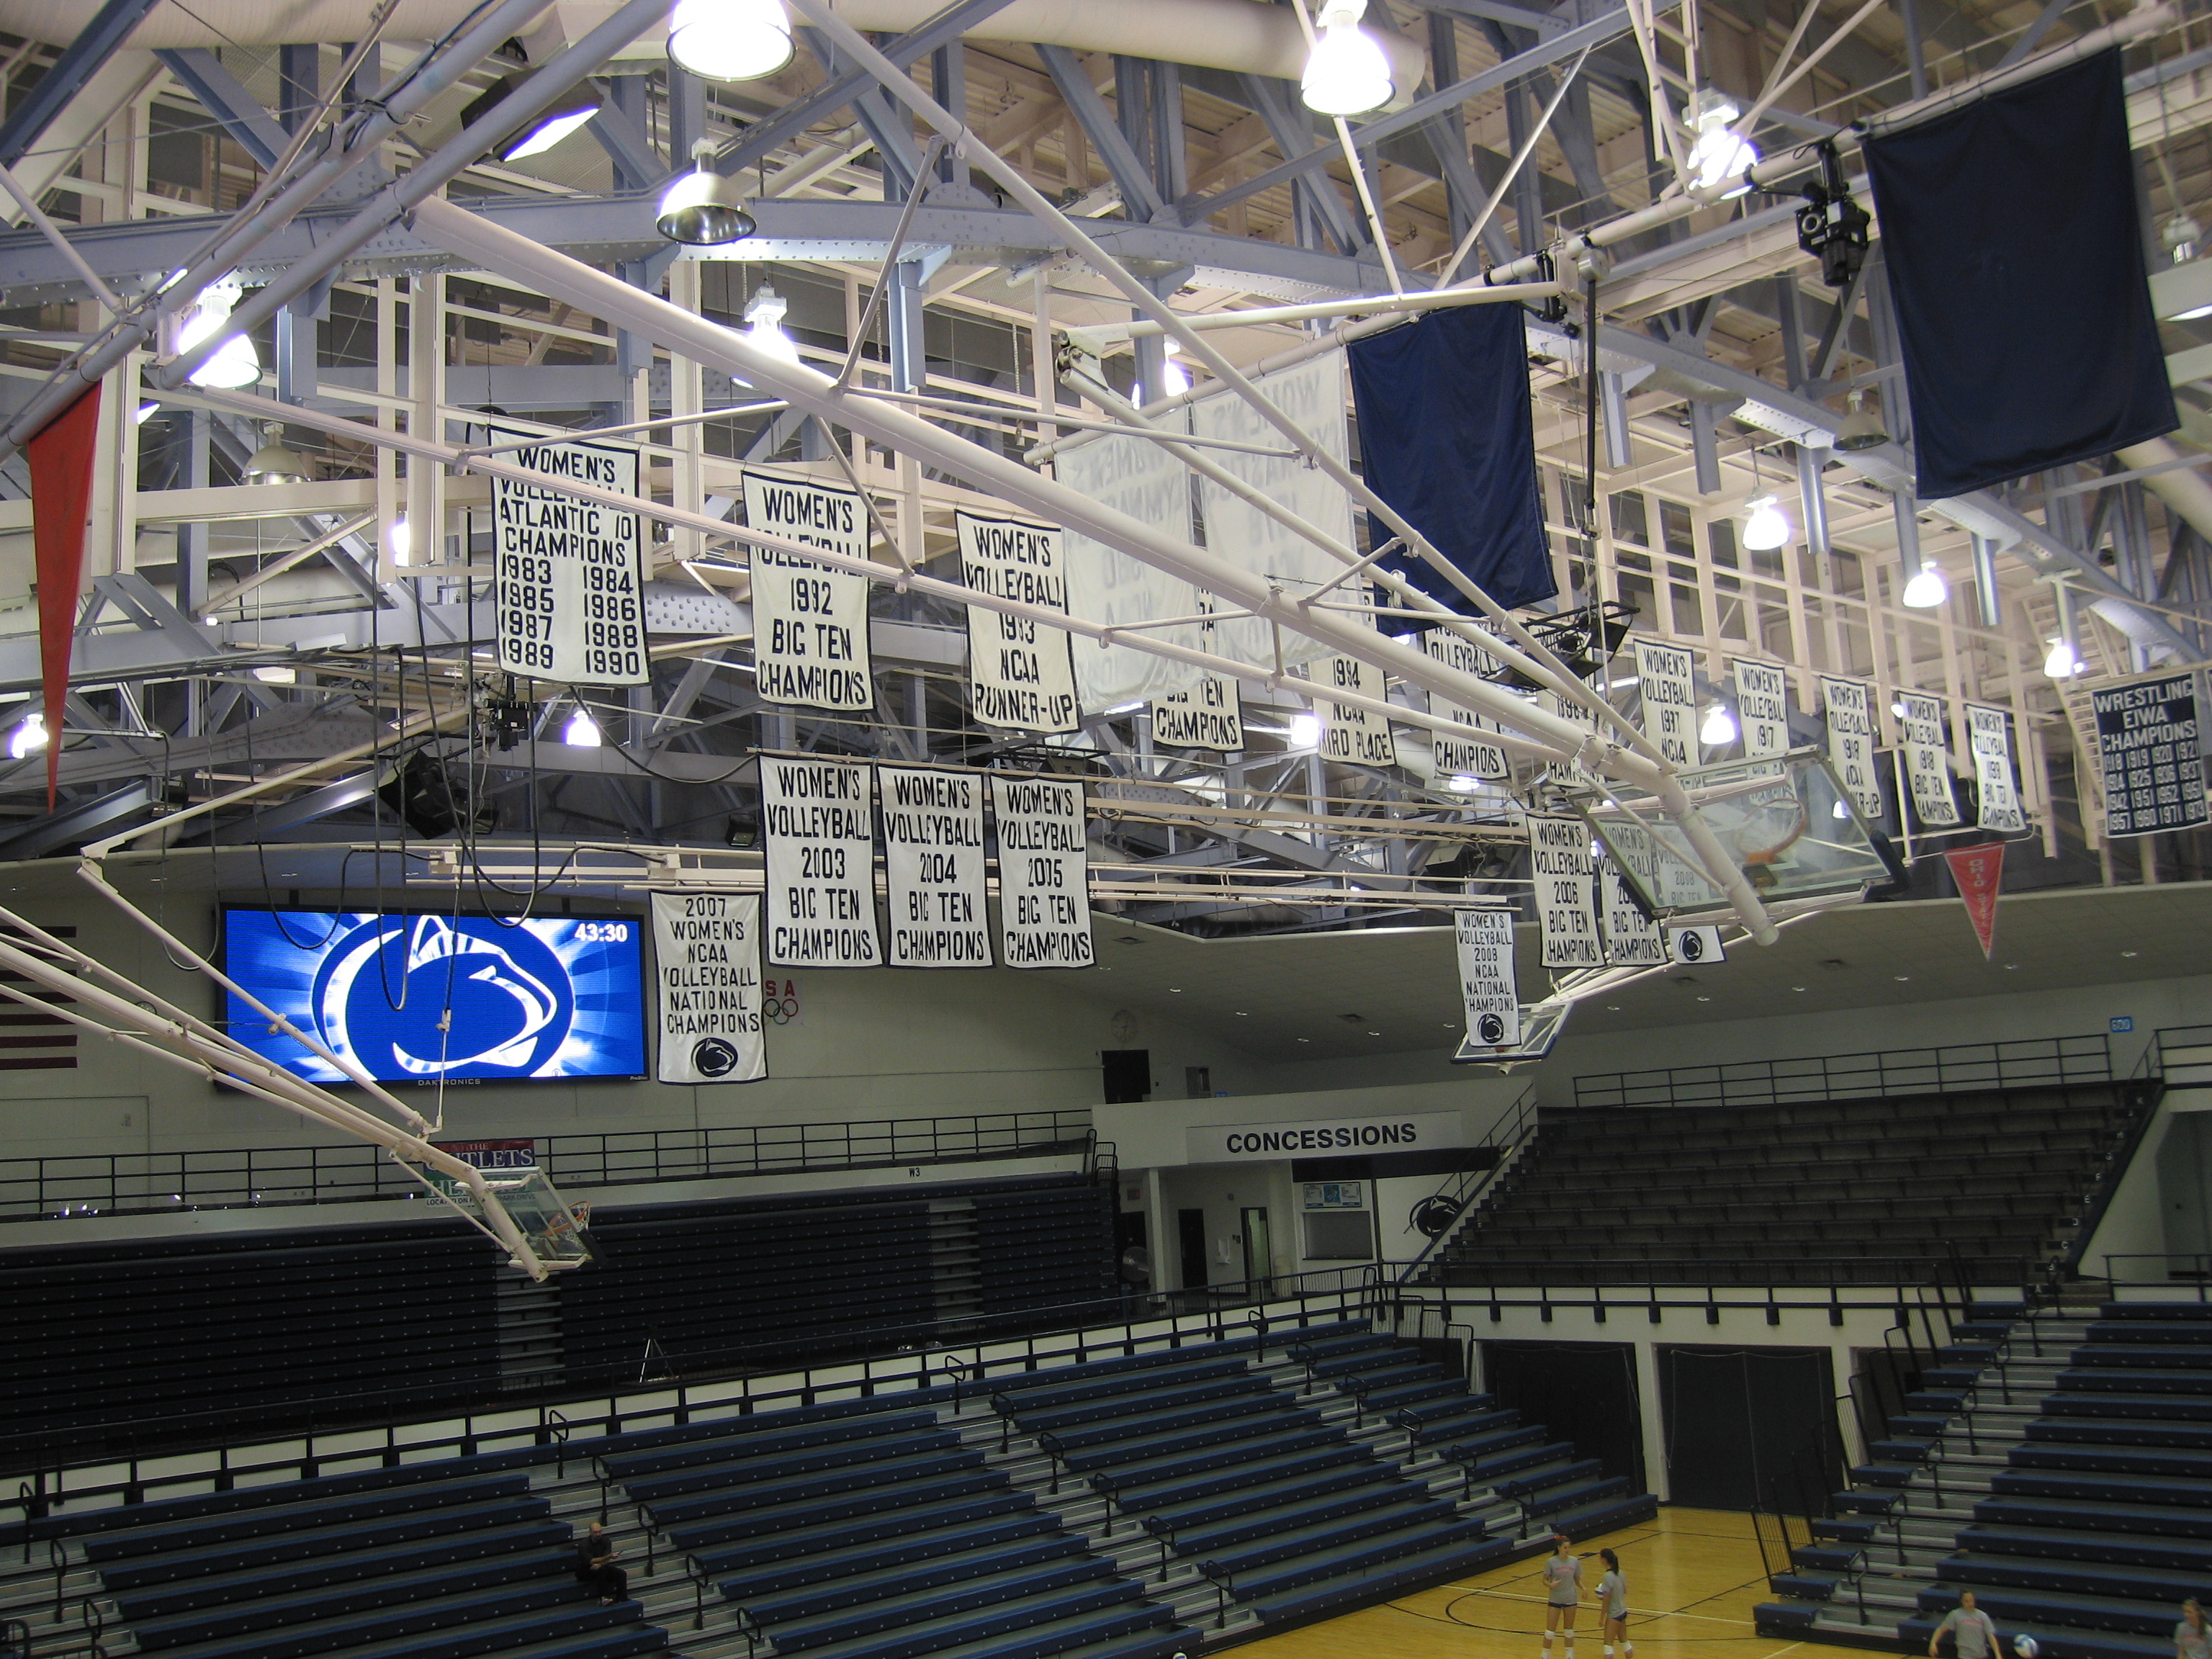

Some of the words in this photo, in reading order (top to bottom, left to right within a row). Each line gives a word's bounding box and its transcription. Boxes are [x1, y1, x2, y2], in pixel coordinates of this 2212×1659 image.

[518, 446, 615, 483] WOMEN'S
[500, 498, 600, 535] ATLANTIC
[616, 514, 631, 540] 10
[763, 487, 853, 533] WOMEN'S
[505, 526, 626, 567] CHAMPIONS
[974, 526, 1051, 567] WOMEN'S
[502, 552, 552, 584] 1983
[583, 565, 634, 595] 1984
[965, 561, 1062, 607] VOLLEYBALL
[501, 580, 554, 613] 1985
[584, 593, 636, 621] 1986
[791, 578, 833, 615] 1992
[501, 608, 552, 641] 1987
[585, 620, 638, 648] 1988
[772, 619, 805, 655] BIG
[815, 623, 852, 661] TEN
[999, 612, 1035, 644] 1993
[502, 637, 553, 669] 1989
[585, 649, 639, 675] 1990
[1000, 648, 1040, 685] NCAA
[1429, 640, 1497, 675] OLLEYBALL
[1643, 649, 1686, 678] WOMEN'S
[760, 660, 866, 704] CHAMPIONS
[1333, 659, 1360, 689] 1994
[1741, 667, 1779, 695] WOMEN'S
[975, 683, 1073, 726] RUNNER-UP
[2094, 679, 2193, 713] WRESTLING
[1156, 707, 1238, 745] CHAMPIONS
[2123, 704, 2168, 729] EIWA
[1319, 729, 1349, 756] HIRD
[1356, 731, 1391, 761] PLACE
[1758, 724, 1773, 748] 197
[2101, 719, 2196, 752] CHAMPIONS
[778, 765, 859, 800] WOMEN'S
[894, 775, 969, 809] WOMEN'S
[1007, 784, 1073, 817] WOMEN'S
[768, 804, 870, 840] VOLLEYBALL
[886, 812, 981, 847] VOLLEYBALL
[997, 818, 1084, 852] VOLLEYBALL
[1537, 822, 1582, 848] WOMEN'S
[802, 848, 845, 879] 2003
[920, 853, 957, 884] 2004
[1028, 858, 1062, 888] 2005
[1534, 850, 1593, 876] VOLLEYBALL
[685, 897, 726, 917] 2007
[788, 887, 816, 919] BIG
[825, 889, 859, 920] TEN
[909, 891, 928, 922] BIG
[938, 892, 972, 922] TEN
[1554, 881, 1578, 904] 2006
[1018, 895, 1041, 925] BIG
[1048, 894, 1076, 924] TEN
[1462, 913, 1504, 929] WOMEN'S
[1549, 910, 1566, 933] BIG
[1569, 910, 1588, 933] TEN
[1613, 911, 1628, 932] BIG
[575, 922, 628, 942] 43:30
[670, 919, 744, 940] WOMEN'S
[775, 927, 873, 960] CHAMPIONS
[1458, 930, 1512, 945] VOLLEYBALL
[688, 943, 728, 963] NCAA
[897, 930, 984, 961] CHAMPIONS
[1007, 932, 1090, 962] CHAMPIONS
[1475, 948, 1497, 961] 2008
[1547, 939, 1597, 962] HAMPIONS
[661, 967, 757, 987] VOLLEYBALL
[1475, 964, 1498, 978] NCAA
[670, 991, 747, 1011] NATIONAL
[1466, 981, 1511, 995] NATIONAL
[1465, 997, 1514, 1012] HAMPIONS
[667, 1013, 759, 1034] CHAMPIONS
[1226, 1123, 1416, 1154] CONCESSIONS
[436, 1148, 534, 1170] TLETS
